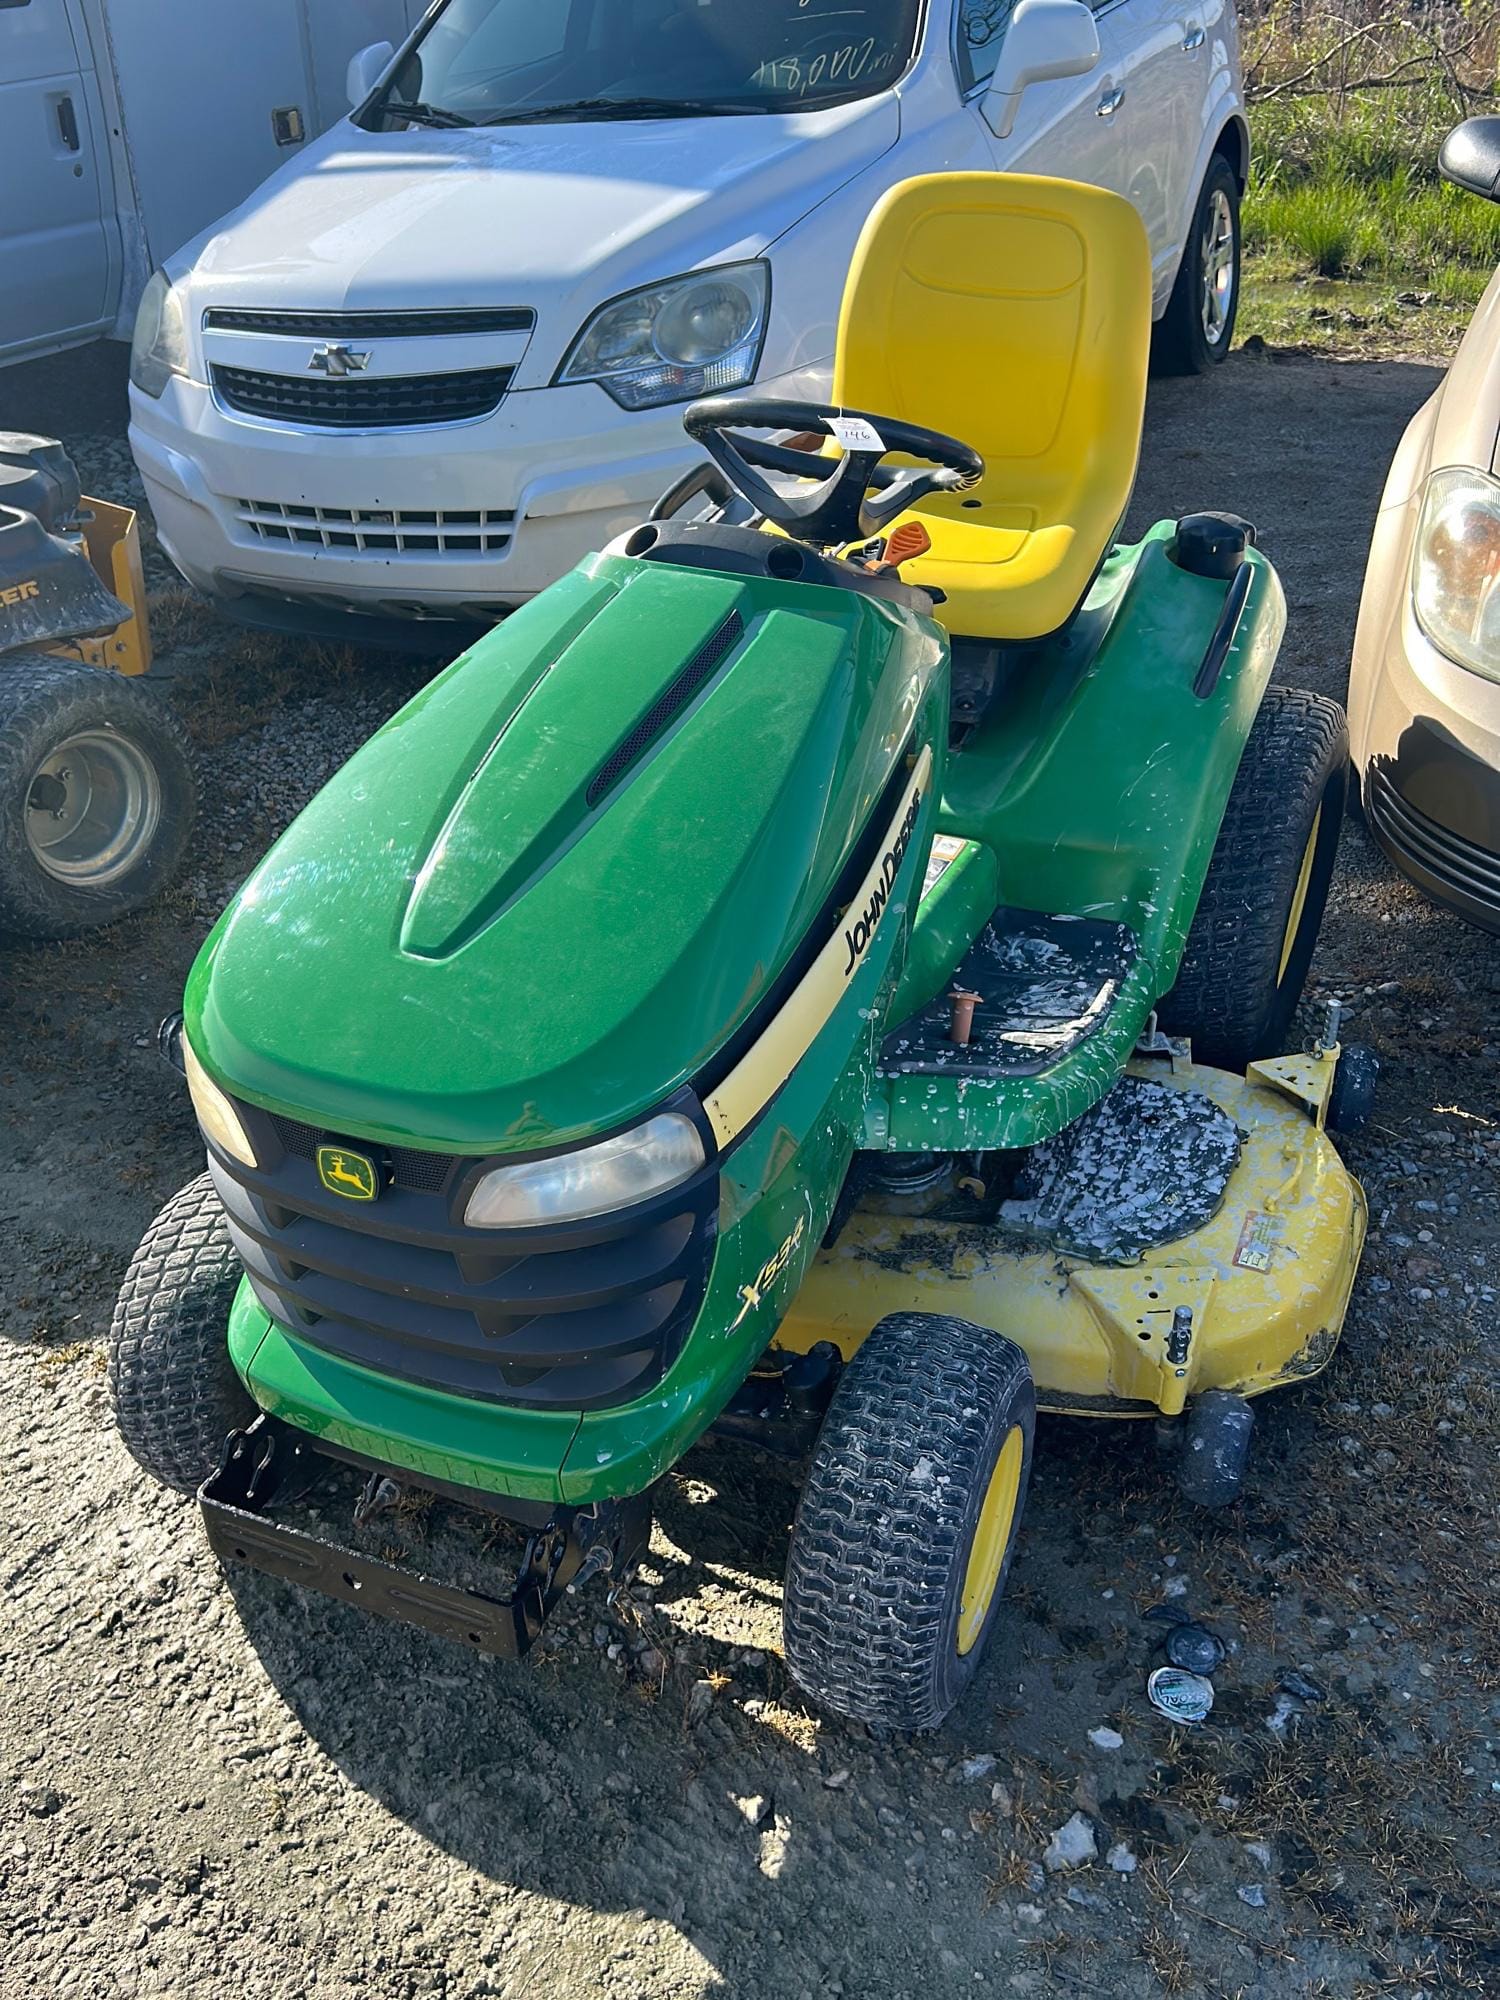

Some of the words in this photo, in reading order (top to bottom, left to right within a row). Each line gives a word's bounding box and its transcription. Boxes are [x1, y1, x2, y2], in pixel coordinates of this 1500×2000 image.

[845, 431, 871, 441] 146
[0, 580, 40, 608] ER
[845, 877, 887, 976] JOHN
[882, 787, 921, 895] DEERE
[726, 1214, 805, 1337] X534
